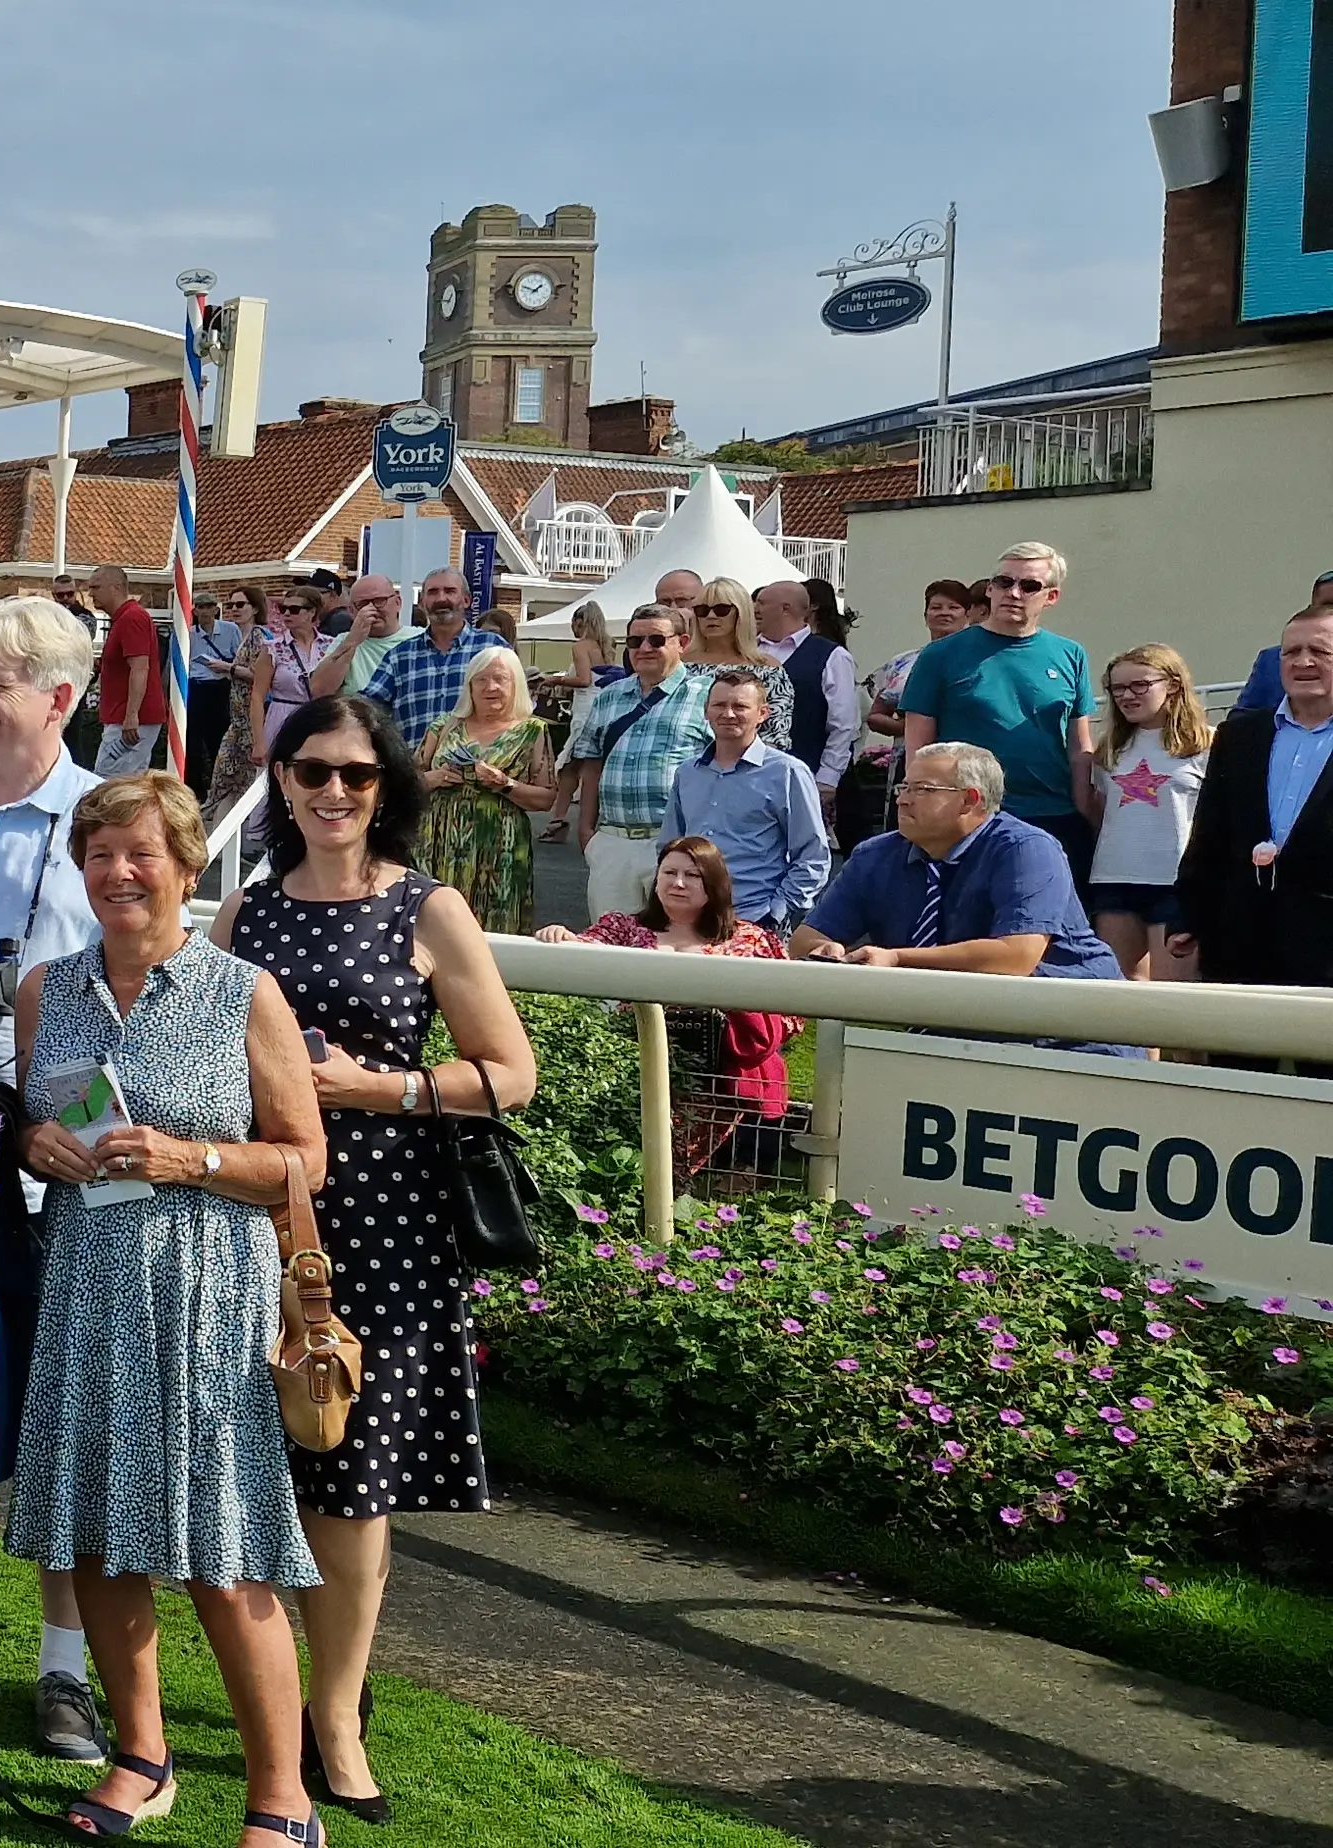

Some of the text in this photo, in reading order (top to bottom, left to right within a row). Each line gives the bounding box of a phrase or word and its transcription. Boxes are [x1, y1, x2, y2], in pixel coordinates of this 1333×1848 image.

[837, 297, 910, 314] Club Lounge
[382, 441, 445, 465] York
[400, 484, 424, 492] York
